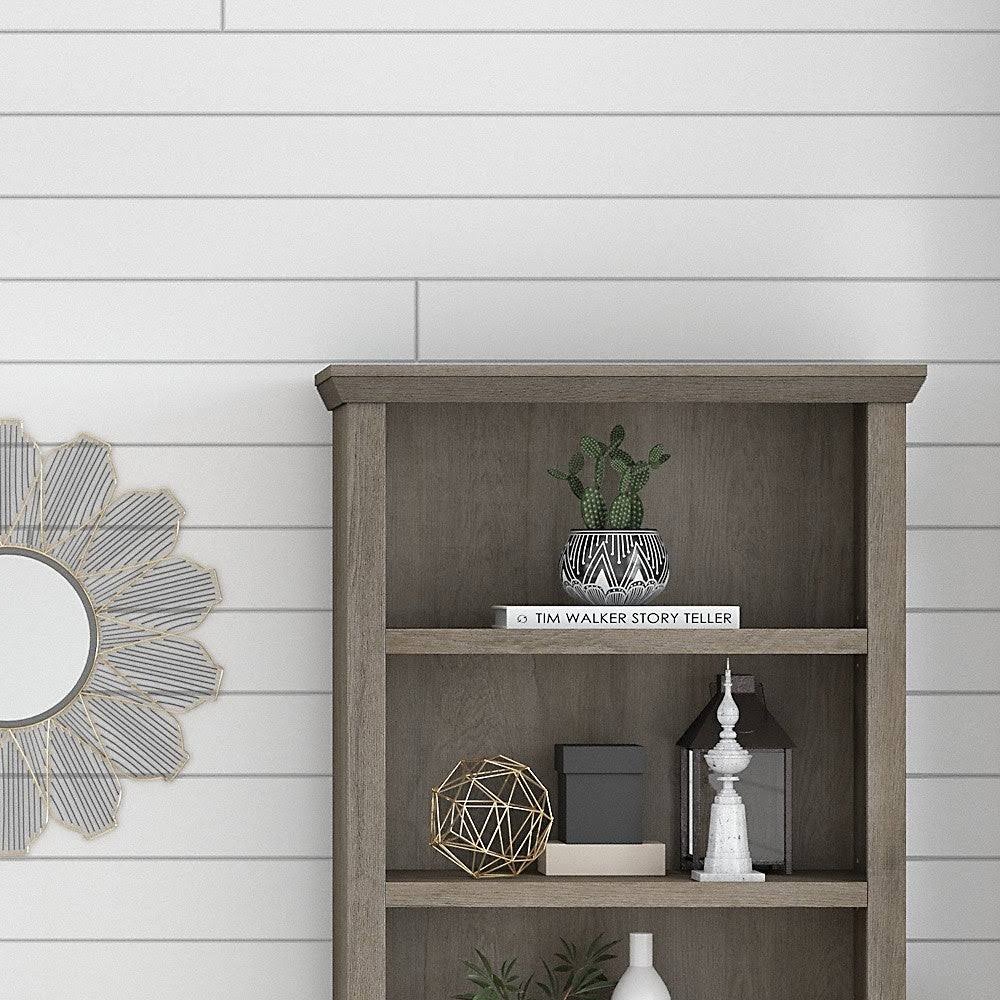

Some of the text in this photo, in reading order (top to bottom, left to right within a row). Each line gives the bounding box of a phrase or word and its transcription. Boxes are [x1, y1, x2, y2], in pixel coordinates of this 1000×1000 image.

[536, 612, 732, 624] TIM WALKER STORY TELLER
